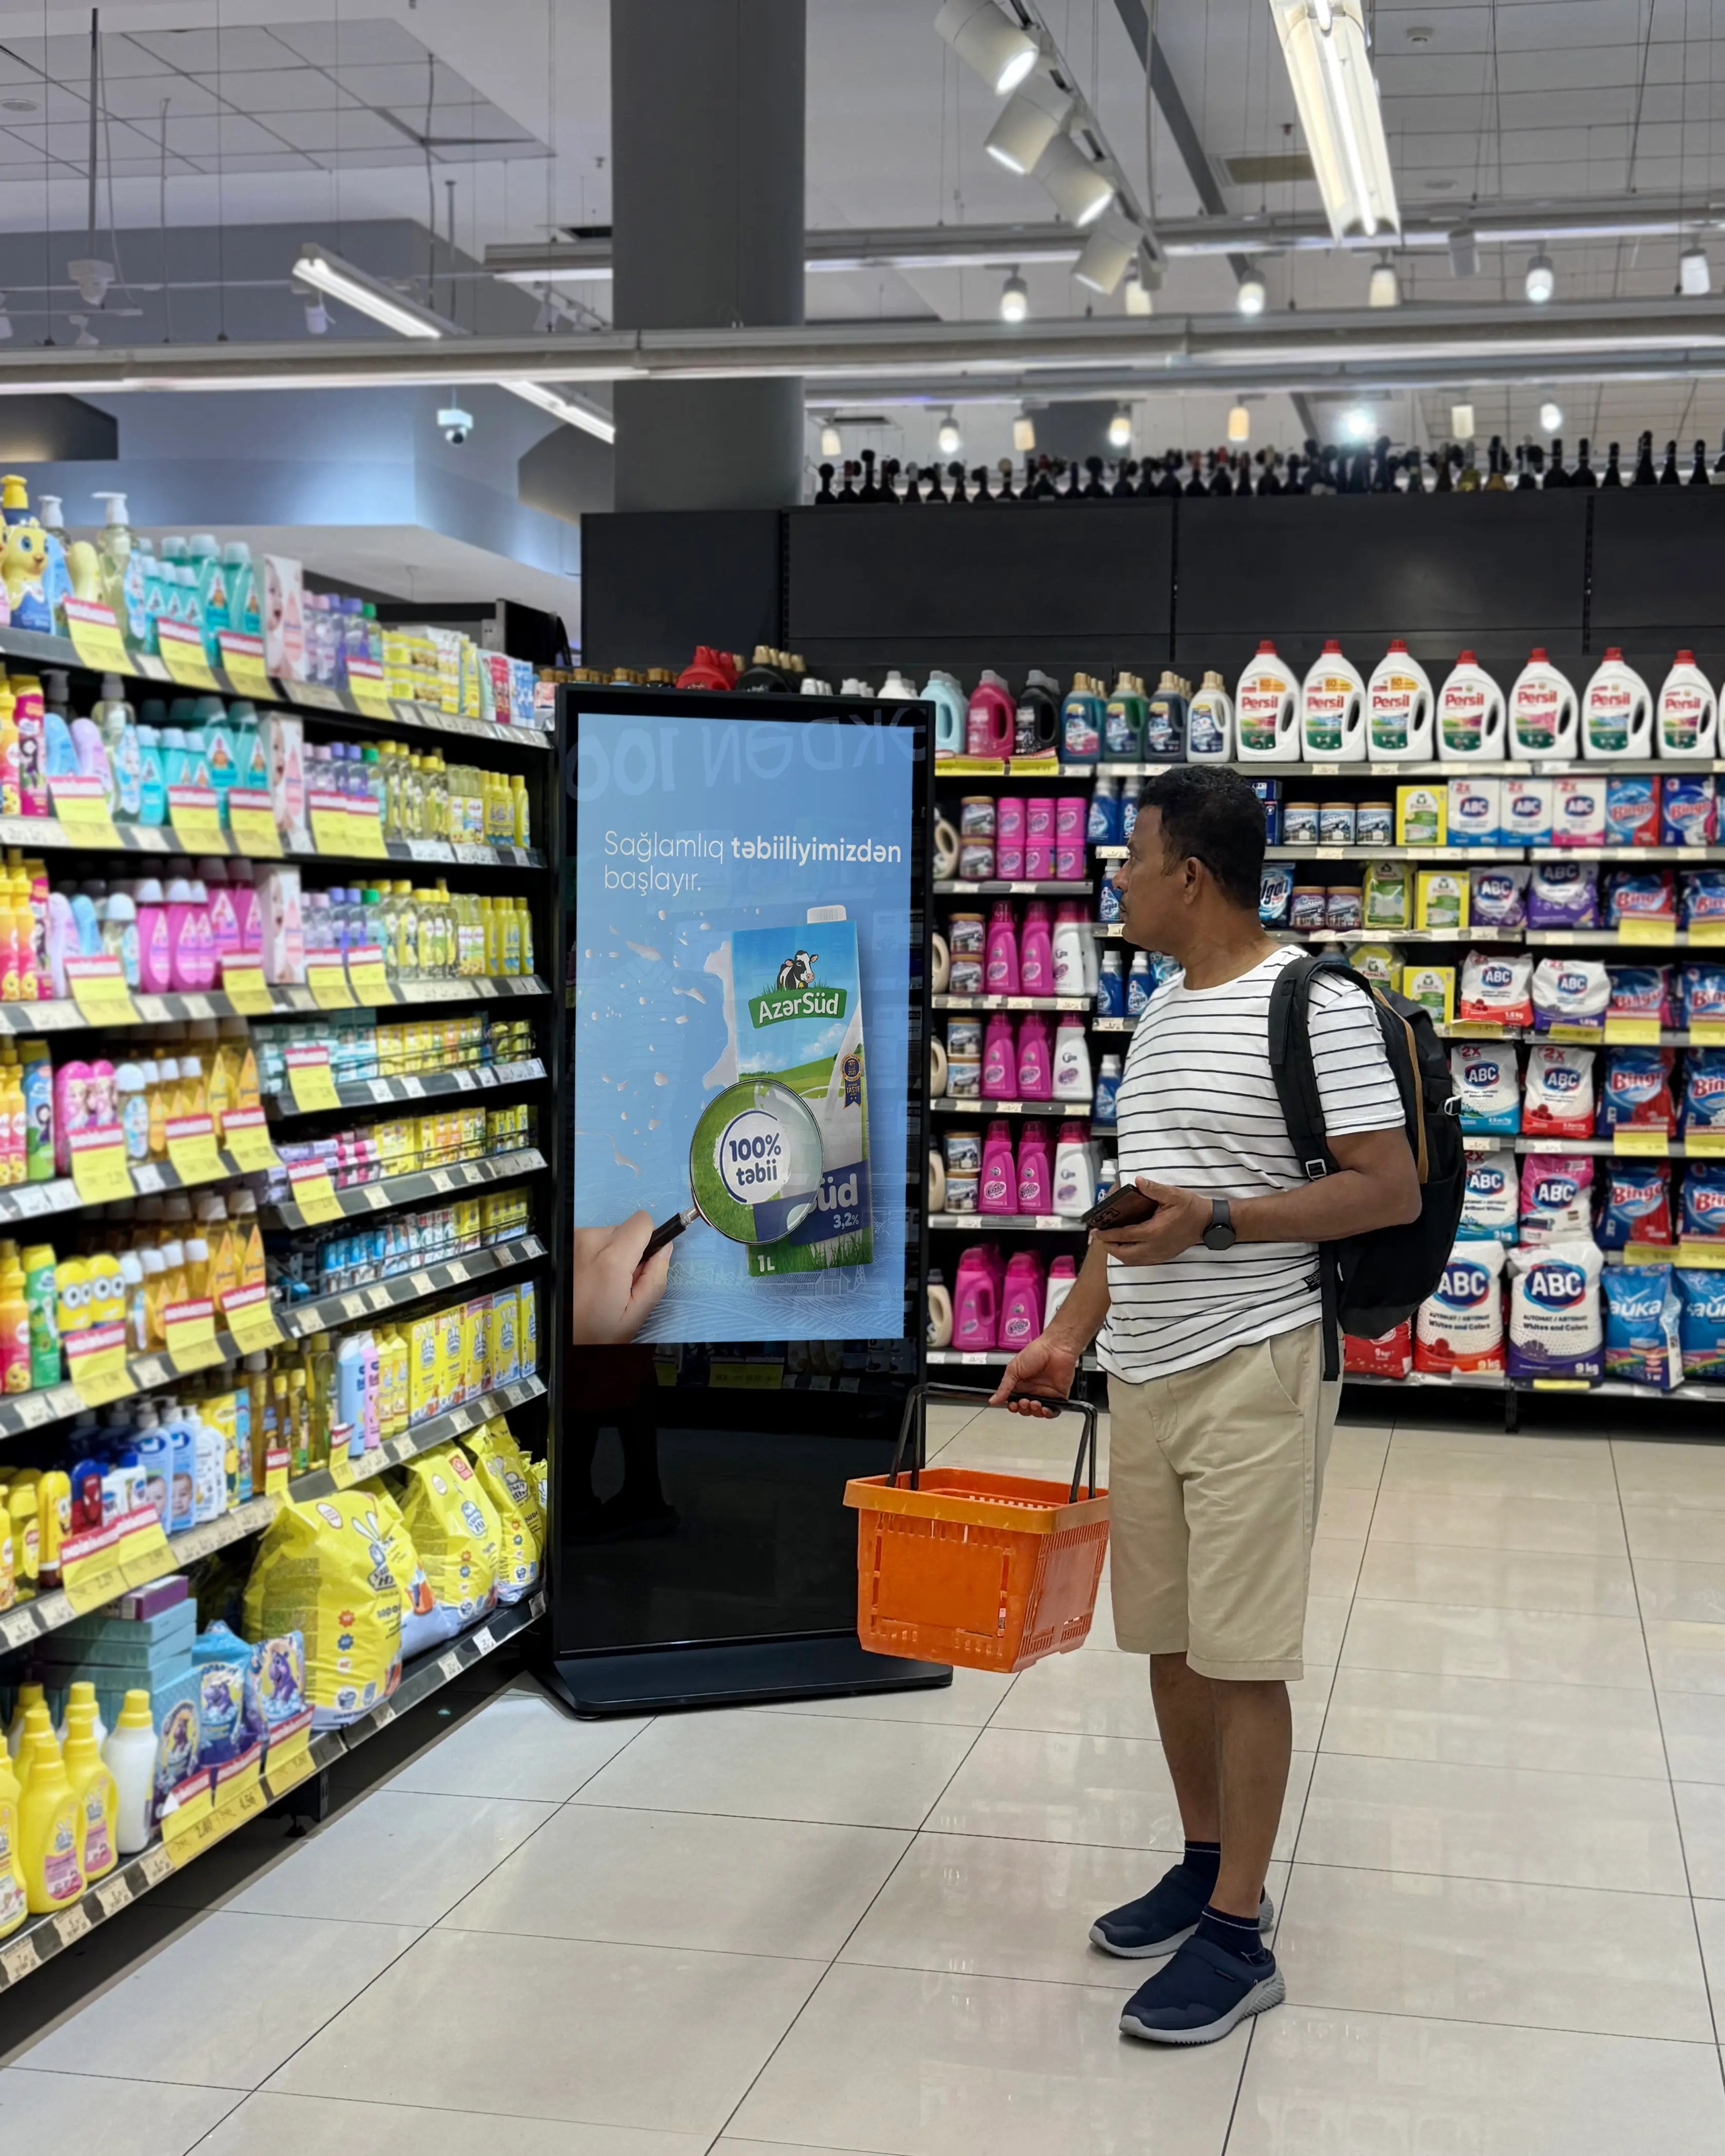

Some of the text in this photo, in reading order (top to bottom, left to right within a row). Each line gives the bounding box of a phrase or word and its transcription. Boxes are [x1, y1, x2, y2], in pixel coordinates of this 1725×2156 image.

[1242, 695, 1278, 709] Persil
[1307, 695, 1344, 709] Persil
[1373, 695, 1410, 708] Persil
[1445, 693, 1484, 706] Persil
[1518, 690, 1557, 705] Persil
[1591, 692, 1630, 706] Persil
[1665, 697, 1700, 710] Persil
[1462, 801, 1486, 813] ABC
[1515, 801, 1540, 813] ABC
[1567, 801, 1592, 813] ABC
[604, 830, 902, 867] Sağlamlıq təbiiliyimizdən
[1544, 865, 1576, 880] ABC
[605, 864, 702, 897] başlayır.
[1482, 881, 1510, 895] ABC
[1485, 970, 1510, 983] ABC
[1561, 978, 1586, 990] ABC
[759, 992, 839, 1024] AzərSüd
[1468, 1066, 1497, 1082] ABC
[1547, 1073, 1578, 1087] ABC
[729, 1132, 782, 1163] 100%
[1469, 1174, 1501, 1189] ABC
[1538, 1183, 1574, 1201] ABC
[833, 1212, 860, 1229] 3,2%
[1438, 1271, 1486, 1296] ABC
[1531, 1272, 1582, 1297] ABC
[1575, 1363, 1599, 1375] 9 kg
